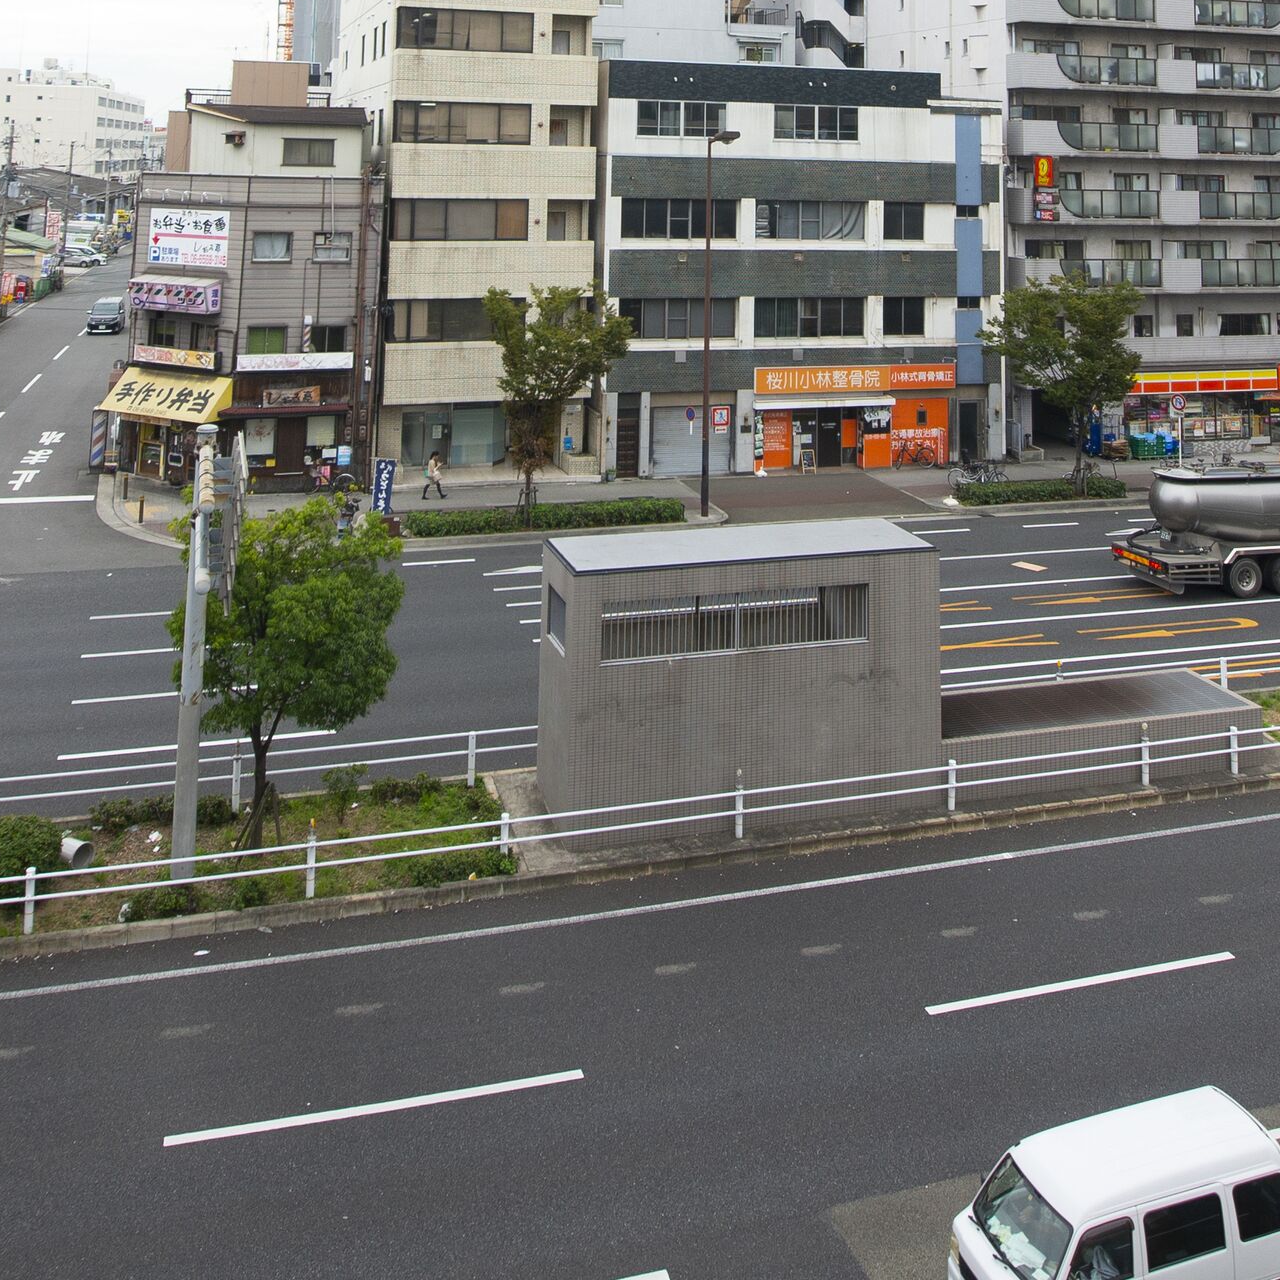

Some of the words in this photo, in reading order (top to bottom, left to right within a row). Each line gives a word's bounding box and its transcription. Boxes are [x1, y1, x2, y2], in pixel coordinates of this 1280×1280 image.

[766, 370, 880, 390] 桜川小林整骨院
[115, 381, 215, 414] 手作り弁当
